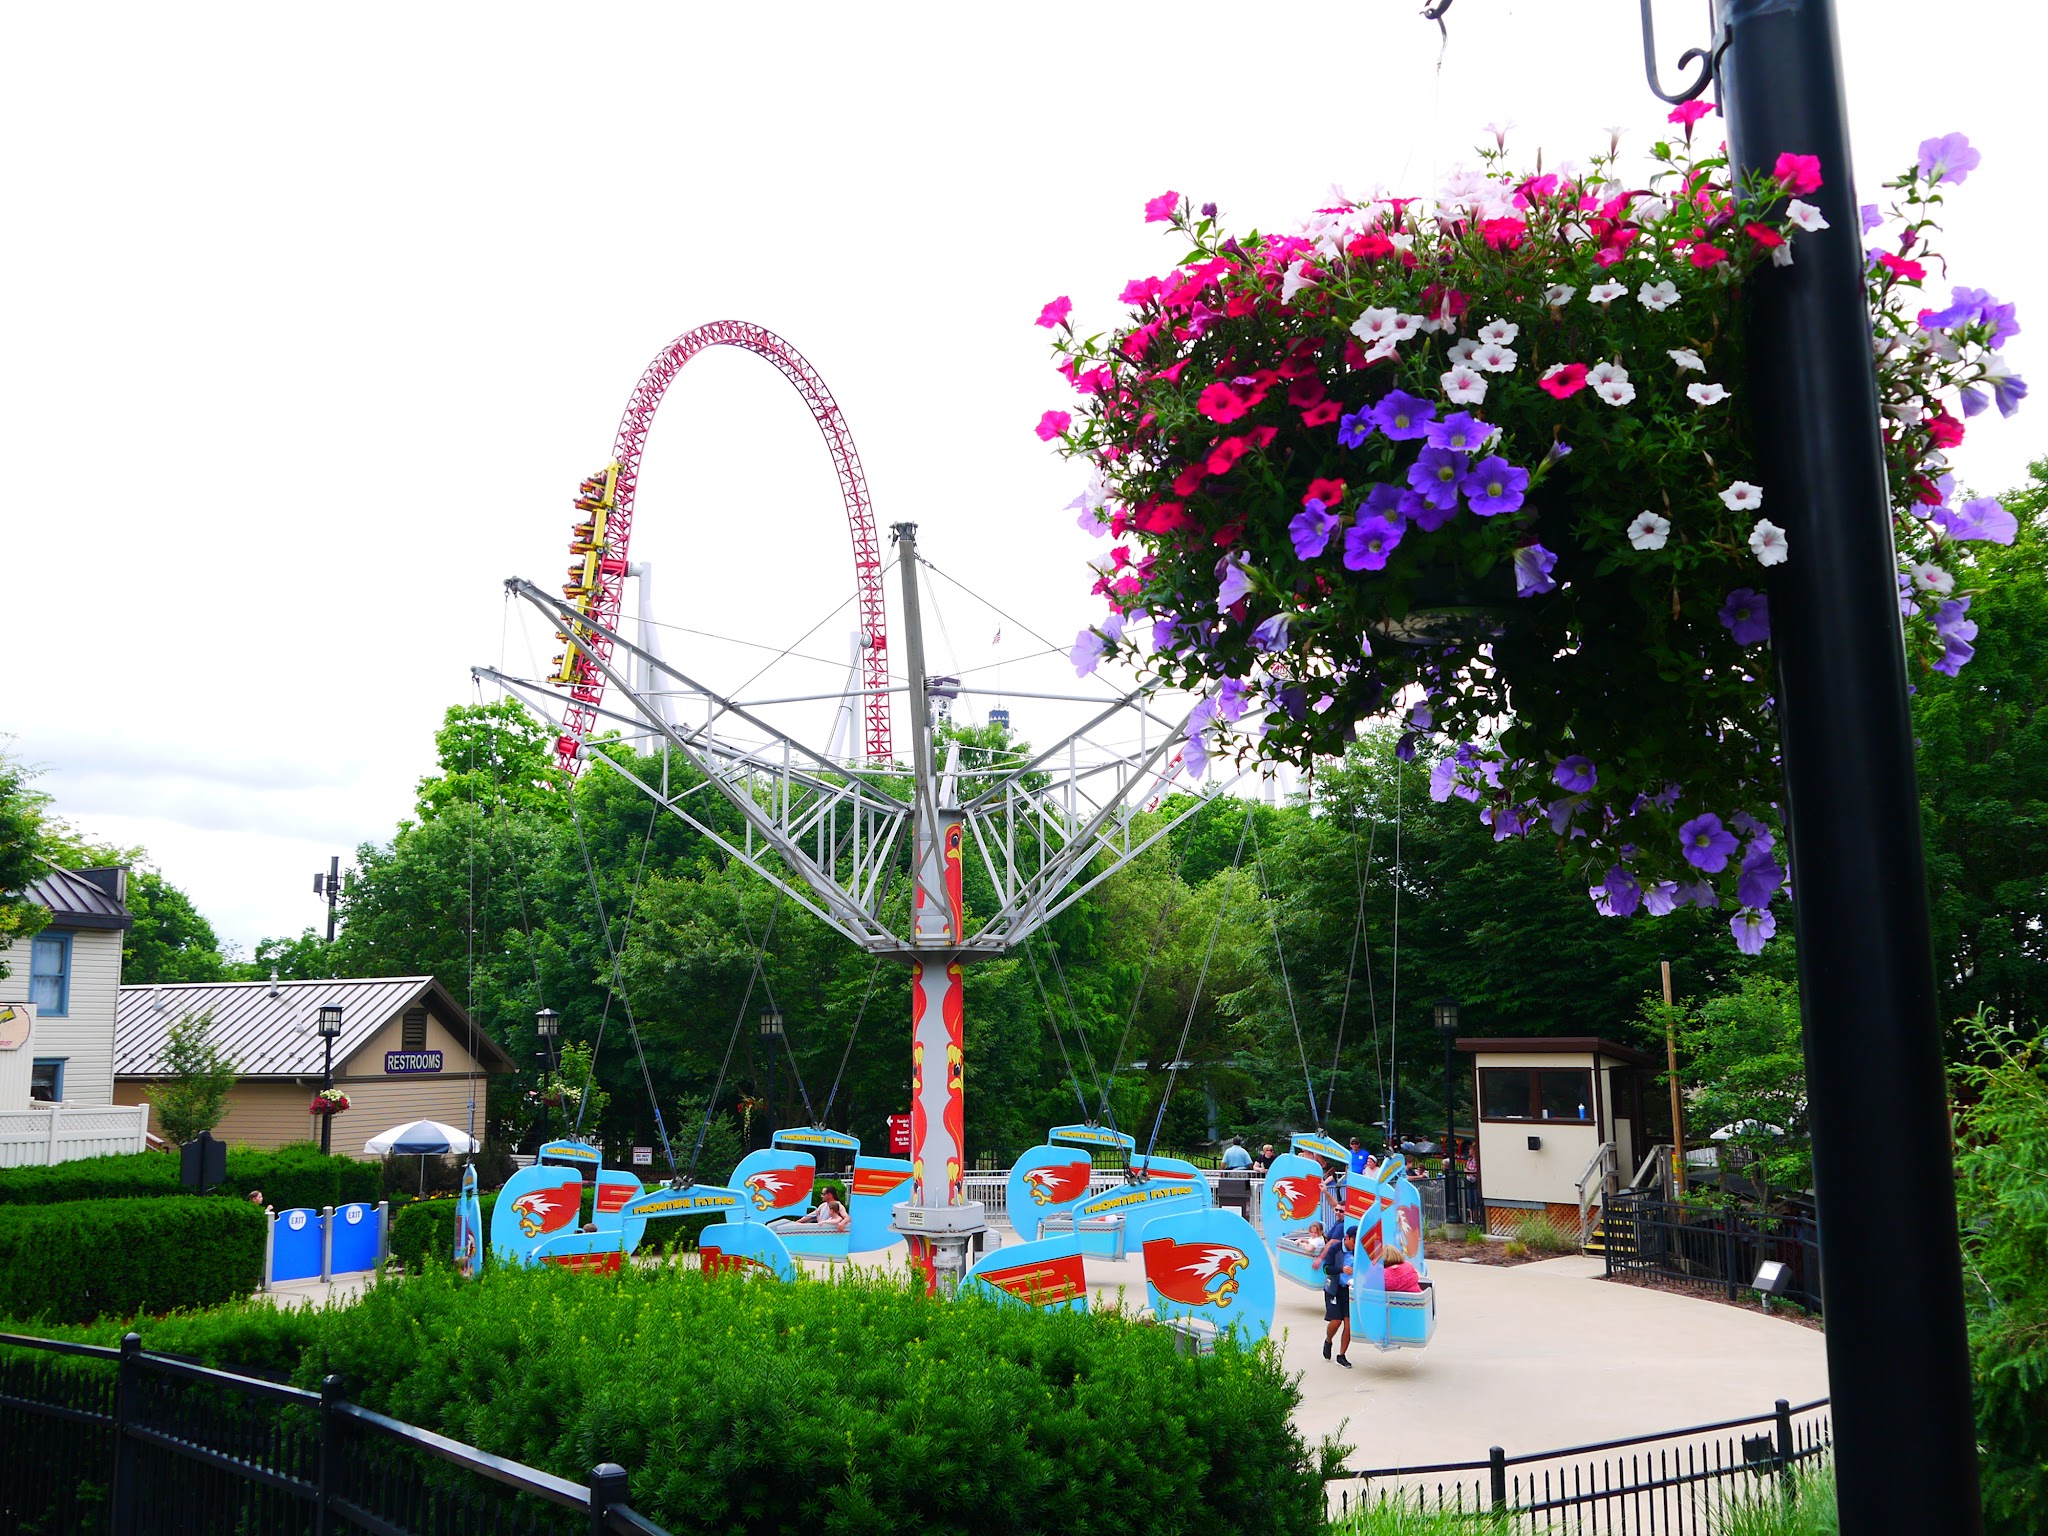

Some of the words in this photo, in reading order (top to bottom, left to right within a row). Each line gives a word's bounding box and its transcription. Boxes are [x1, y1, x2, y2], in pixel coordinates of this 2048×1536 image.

[387, 1054, 441, 1071] RESTROOMS
[633, 1197, 691, 1215] FRONTIER
[694, 1196, 736, 1208] FLYERS
[1084, 1191, 1147, 1215] FRONTIER
[1150, 1186, 1193, 1200] FLYERS
[290, 1216, 305, 1225] EXIT
[348, 1210, 361, 1219] EXIT
